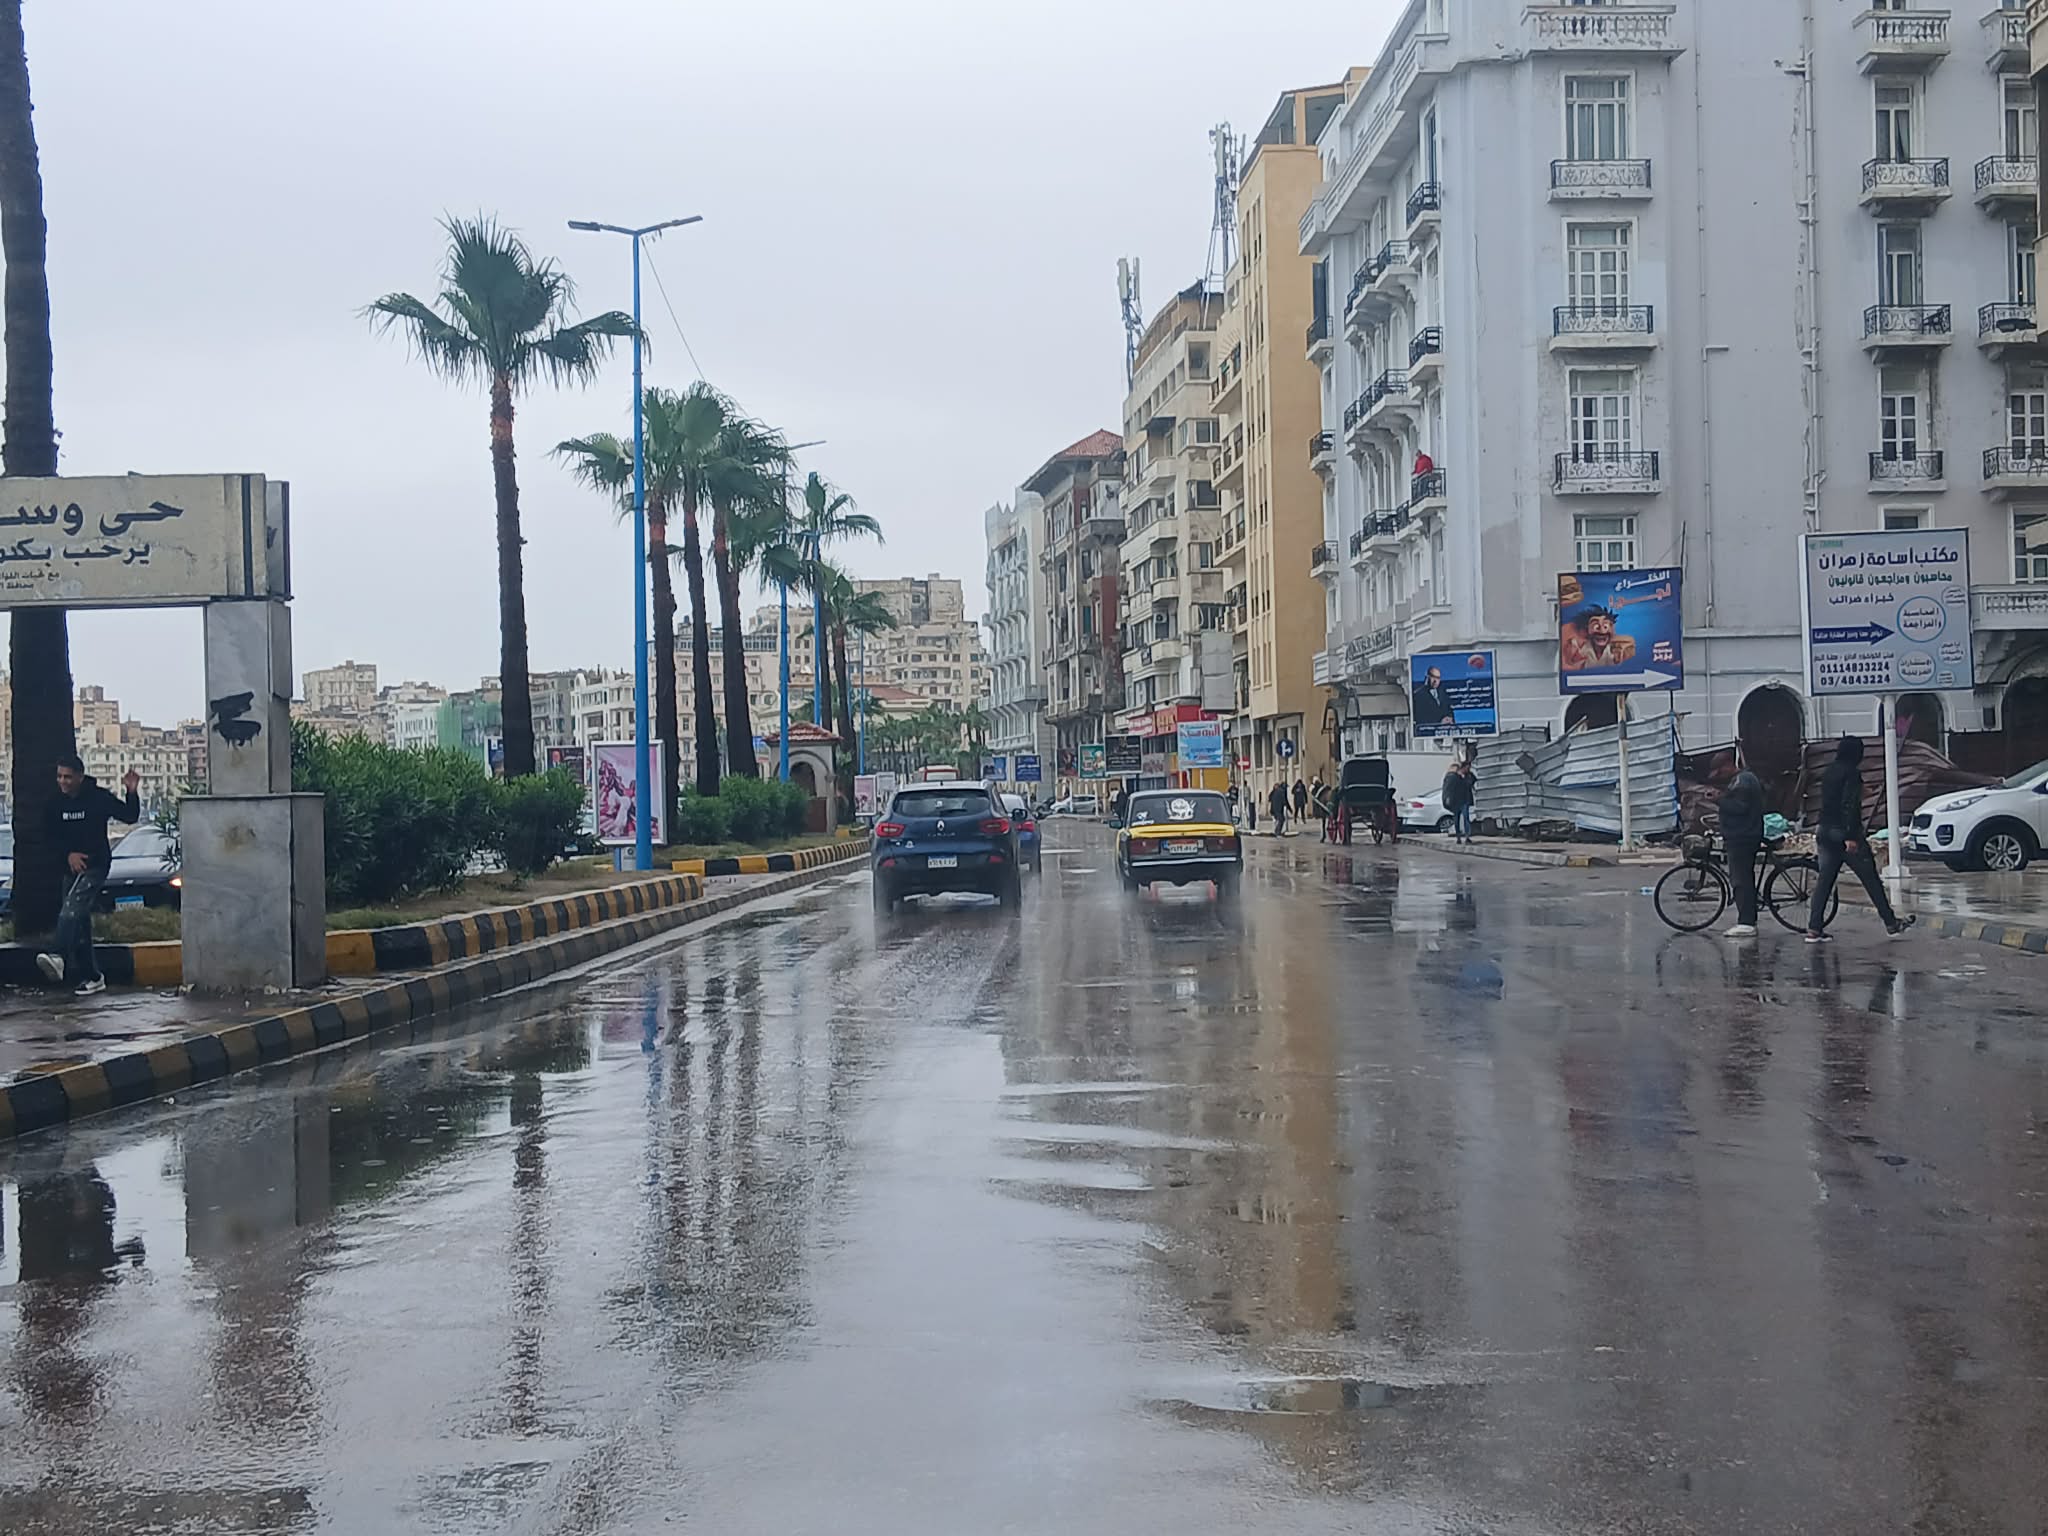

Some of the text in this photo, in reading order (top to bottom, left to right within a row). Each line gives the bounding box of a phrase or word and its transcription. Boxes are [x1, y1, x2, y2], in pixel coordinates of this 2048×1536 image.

[63, 543, 151, 567] يرحب
[1818, 552, 1864, 570] زهران
[1914, 546, 1959, 568] مكتب
[1828, 570, 1953, 588] محاسبون ومراجعون قانونيون
[1828, 592, 1895, 605] خبراء ضرائب
[1902, 607, 1940, 617] المحاسبة
[1903, 620, 1942, 629] والمراجعة
